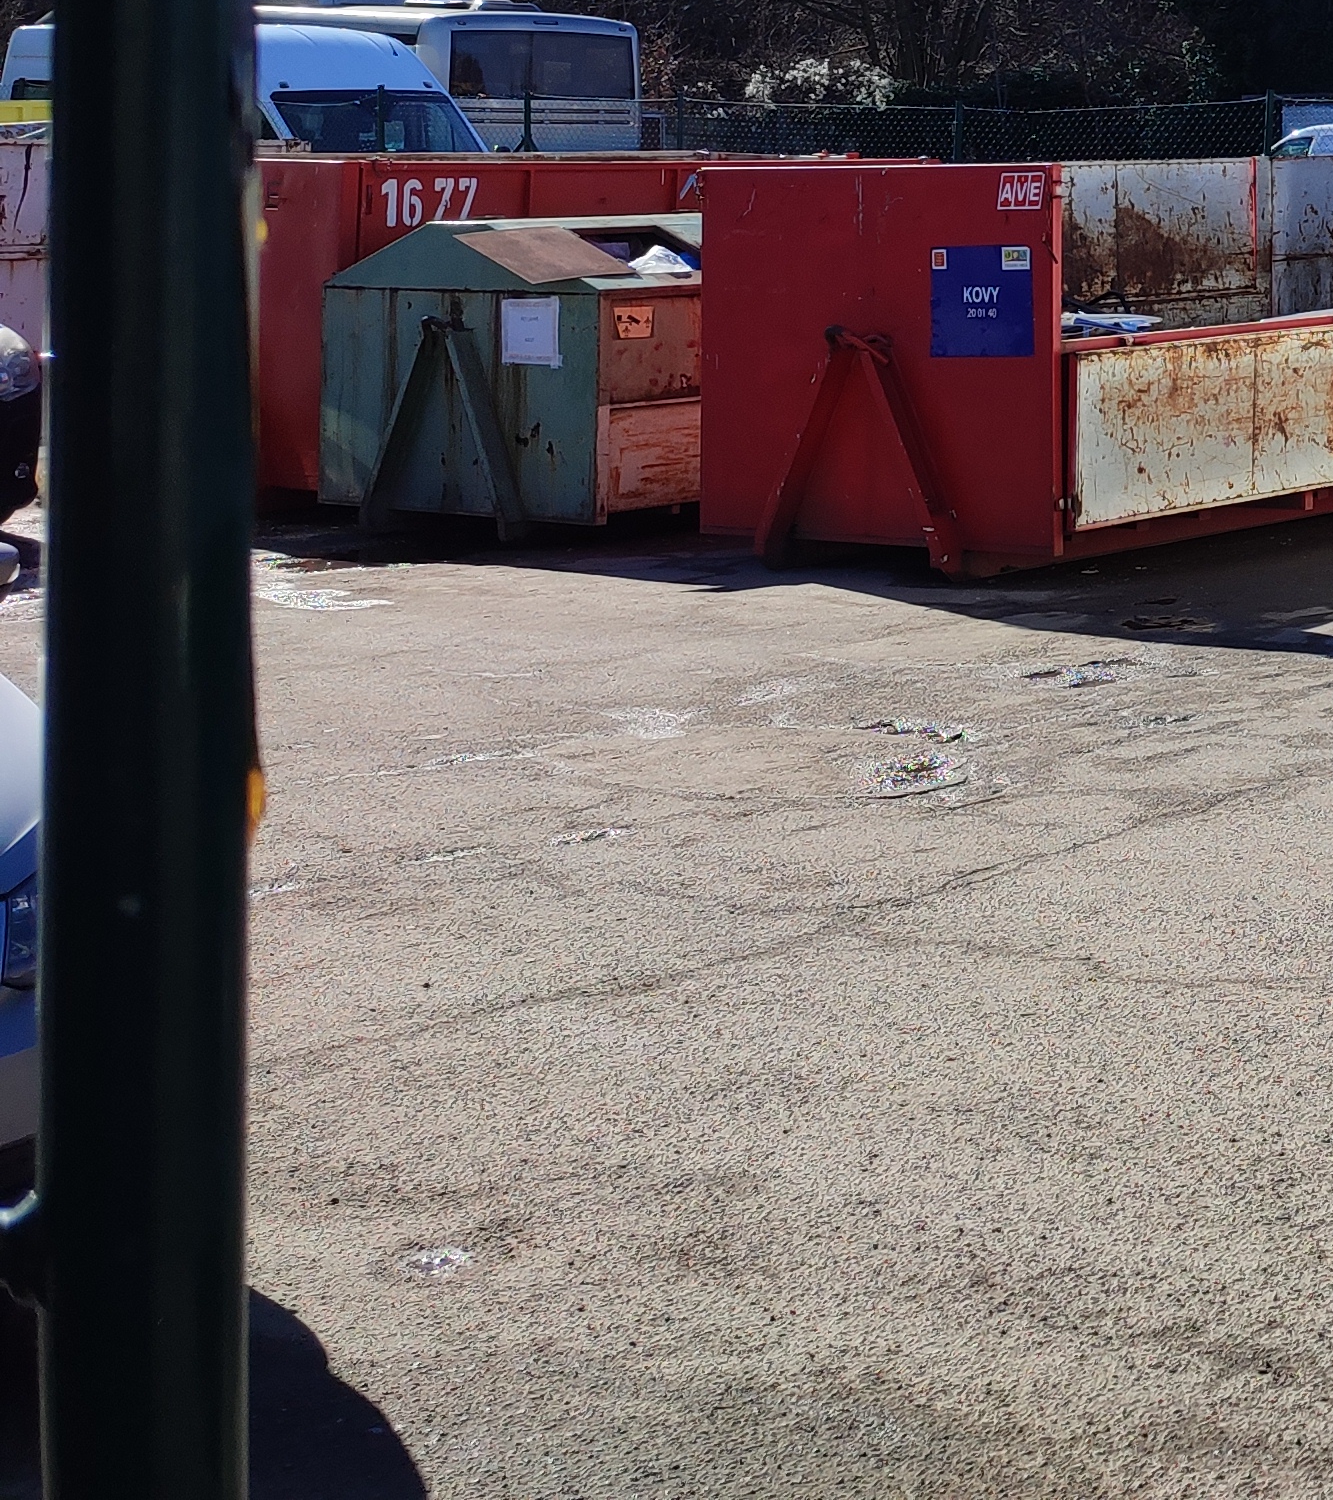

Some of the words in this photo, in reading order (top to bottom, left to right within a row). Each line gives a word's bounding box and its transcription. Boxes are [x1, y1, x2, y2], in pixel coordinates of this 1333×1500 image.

[1000, 182, 1042, 202] AVE
[381, 178, 478, 228] 1677
[963, 286, 1000, 304] KOVY
[967, 308, 976, 318] 20
